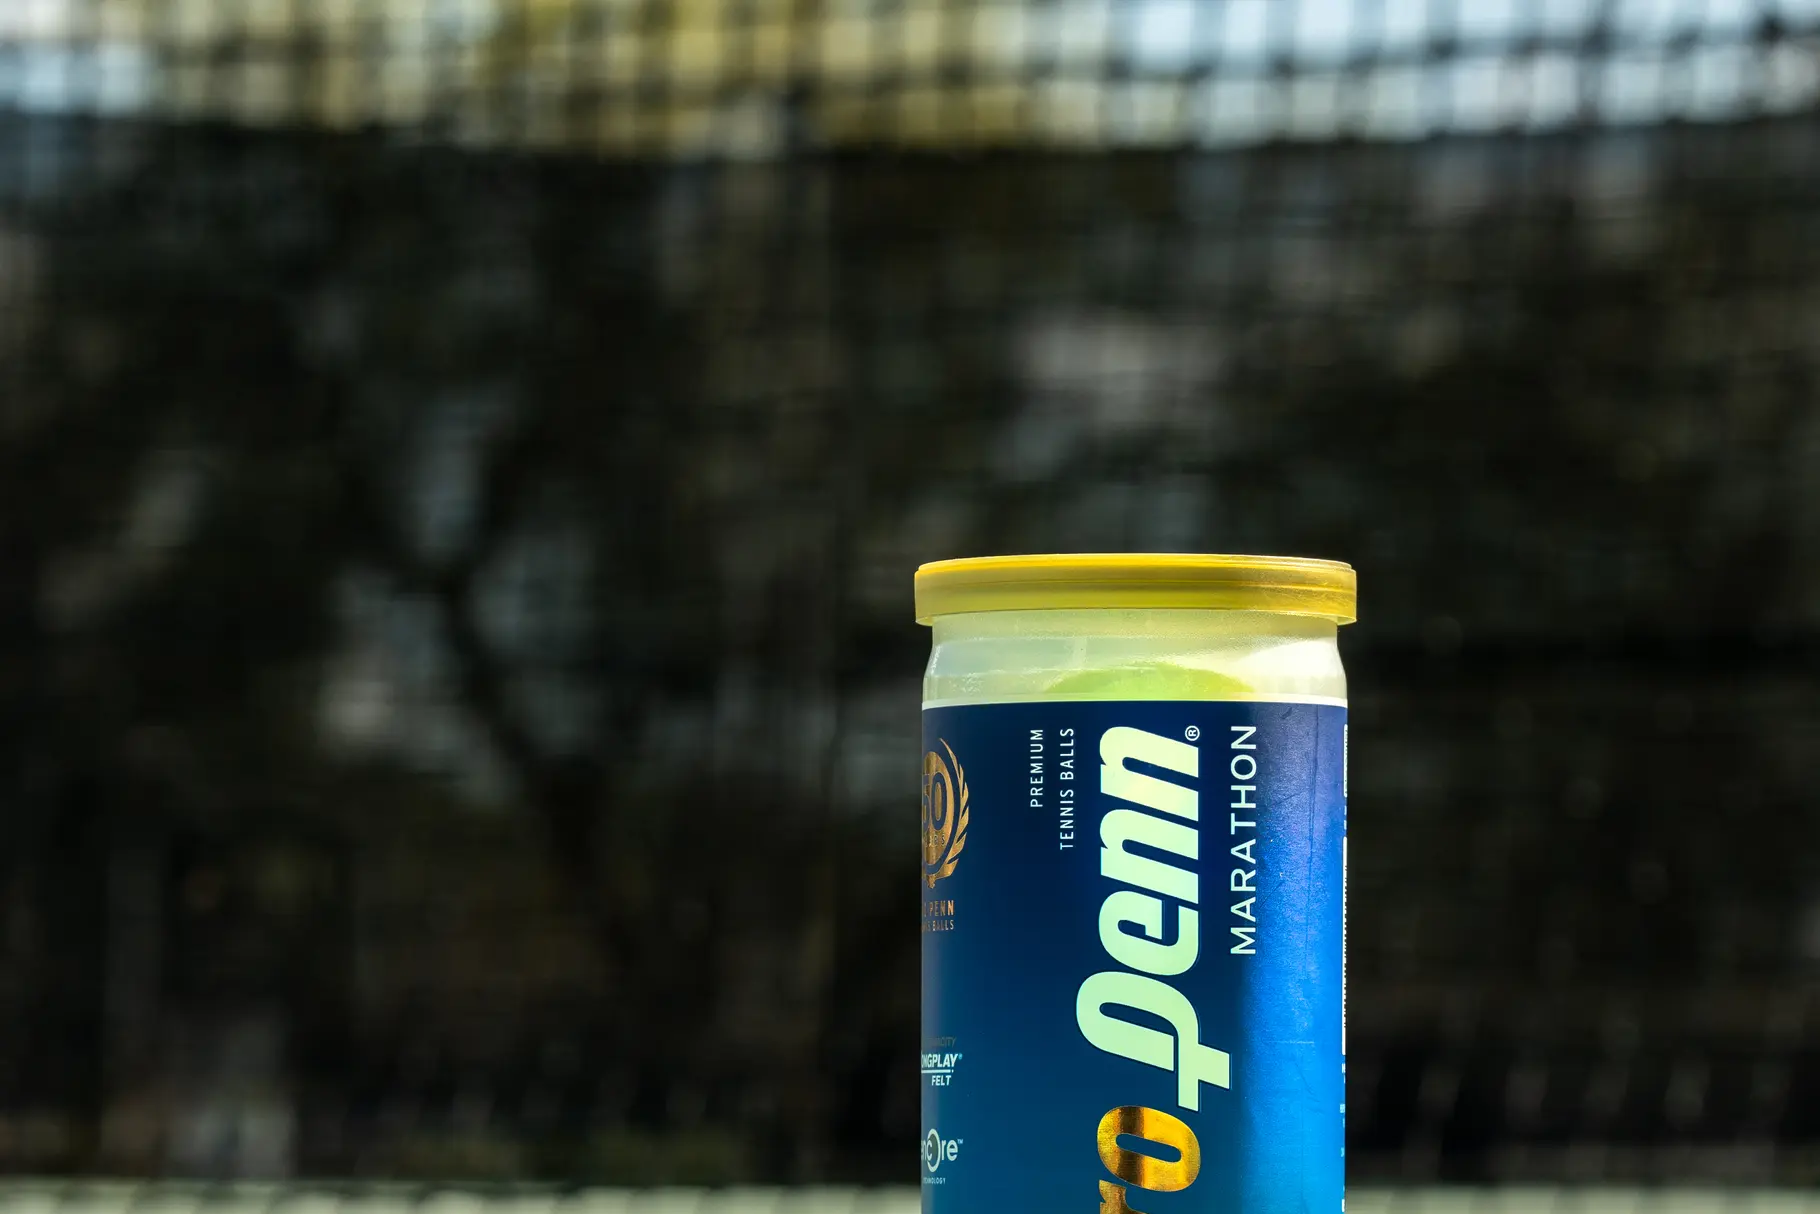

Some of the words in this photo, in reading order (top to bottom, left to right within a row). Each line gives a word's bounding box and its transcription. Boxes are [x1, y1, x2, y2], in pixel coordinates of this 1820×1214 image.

[1030, 727, 1045, 808] PREMIUM
[1059, 727, 1075, 783] BALLS
[1059, 784, 1075, 850] TENNIS
[1230, 724, 1258, 956] MARATHON
[931, 1075, 952, 1087] FELT
